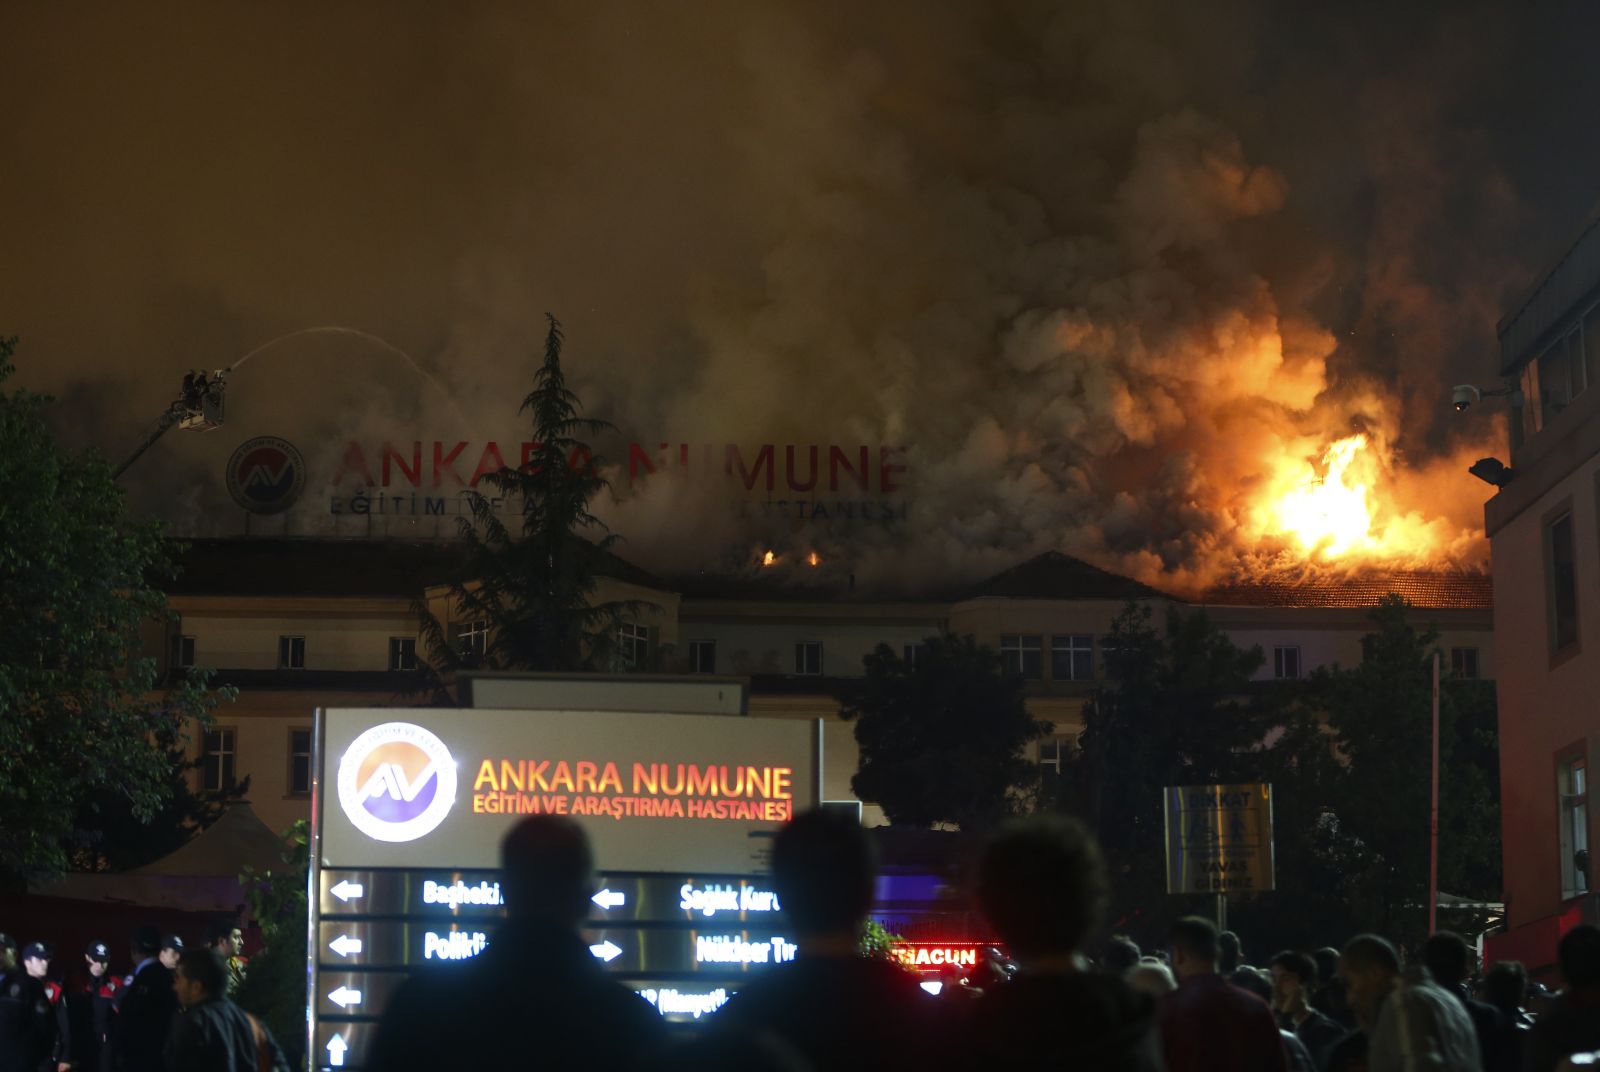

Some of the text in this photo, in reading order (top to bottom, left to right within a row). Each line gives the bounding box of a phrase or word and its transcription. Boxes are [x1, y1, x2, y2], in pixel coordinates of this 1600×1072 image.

[330, 490, 446, 515] EĞİTİM
[473, 759, 793, 799] ANKARA NUMUNE
[473, 791, 793, 822] EĞİTİM VE ARAŞTIRMA HASTANESİ
[423, 880, 504, 910] Başheki
[680, 884, 740, 917] Sağlık
[696, 935, 771, 964] Nükleer
